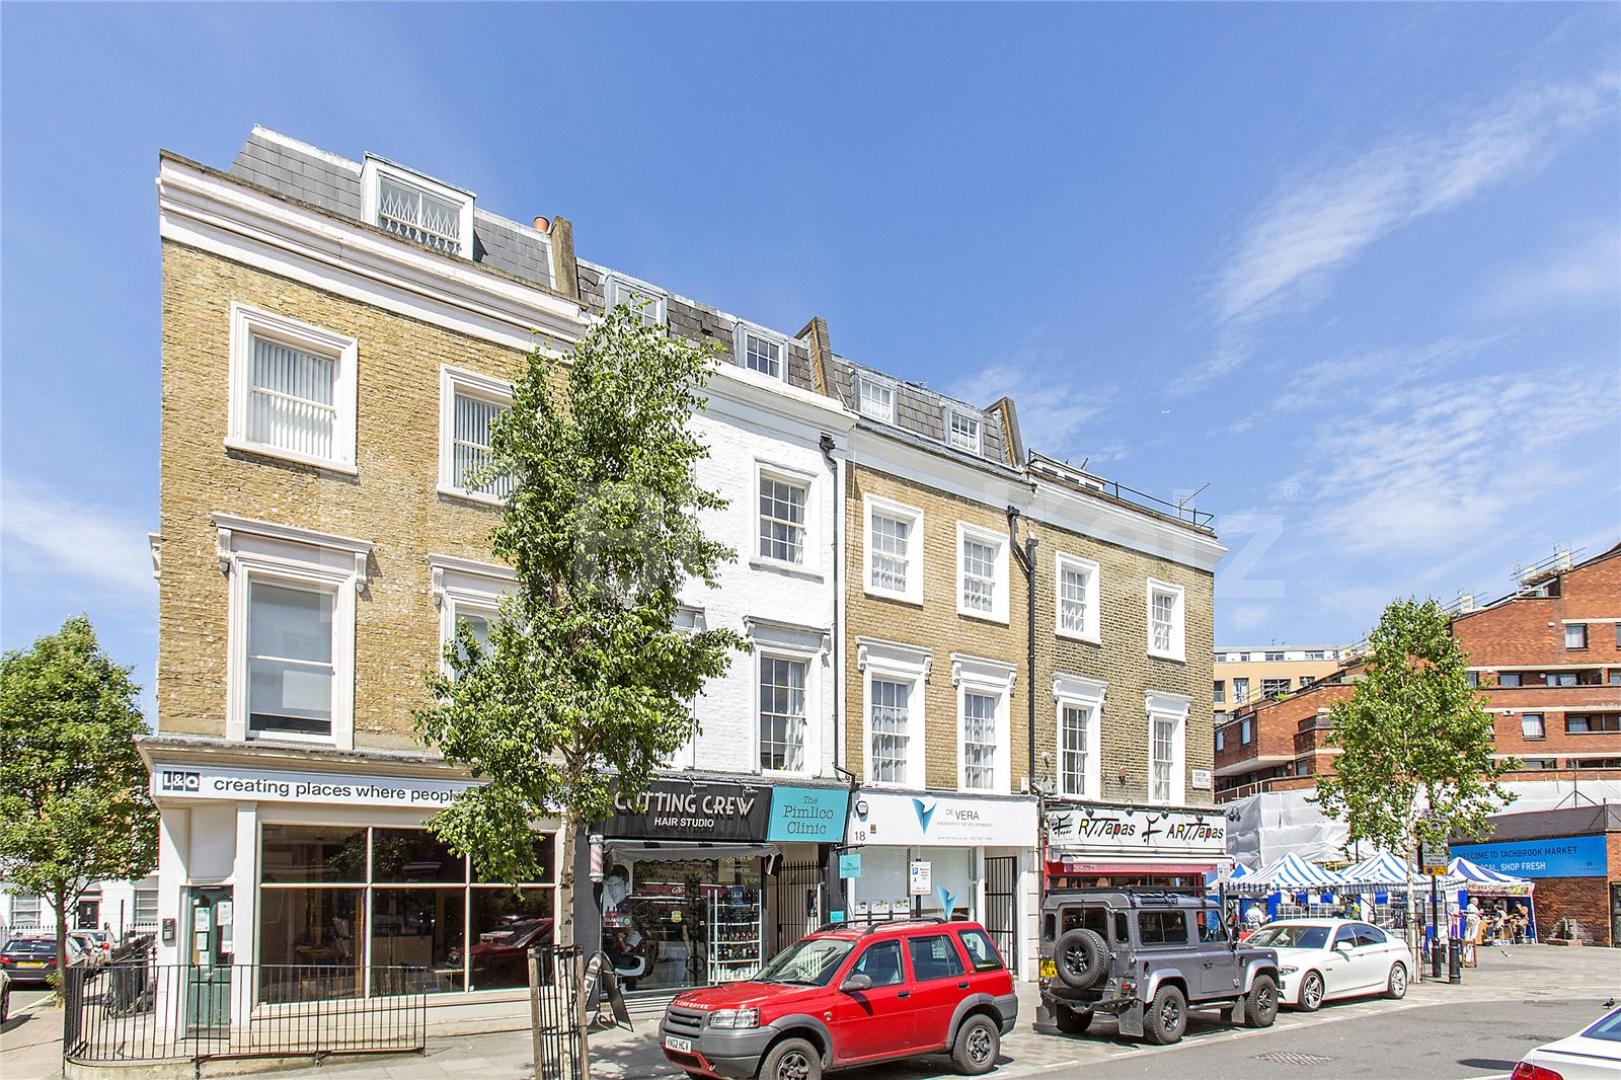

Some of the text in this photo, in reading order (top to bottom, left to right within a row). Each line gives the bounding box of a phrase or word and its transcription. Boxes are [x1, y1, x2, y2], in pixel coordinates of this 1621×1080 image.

[163, 772, 199, 790] L&Q
[213, 779, 290, 797] creating
[296, 782, 351, 798] places
[356, 785, 406, 800] where
[701, 795, 756, 816] CREW
[803, 795, 819, 804] The
[783, 804, 834, 820] Pimlico
[955, 810, 980, 821] VERA
[654, 816, 715, 828] HAIR STUDIO
[786, 821, 827, 835] Clinic
[854, 831, 866, 842] 18
[1460, 845, 1578, 861] ELCOME TO TACHBROOK MARKET
[1501, 863, 1520, 872] SHOP
[1521, 861, 1546, 871] FRESH
